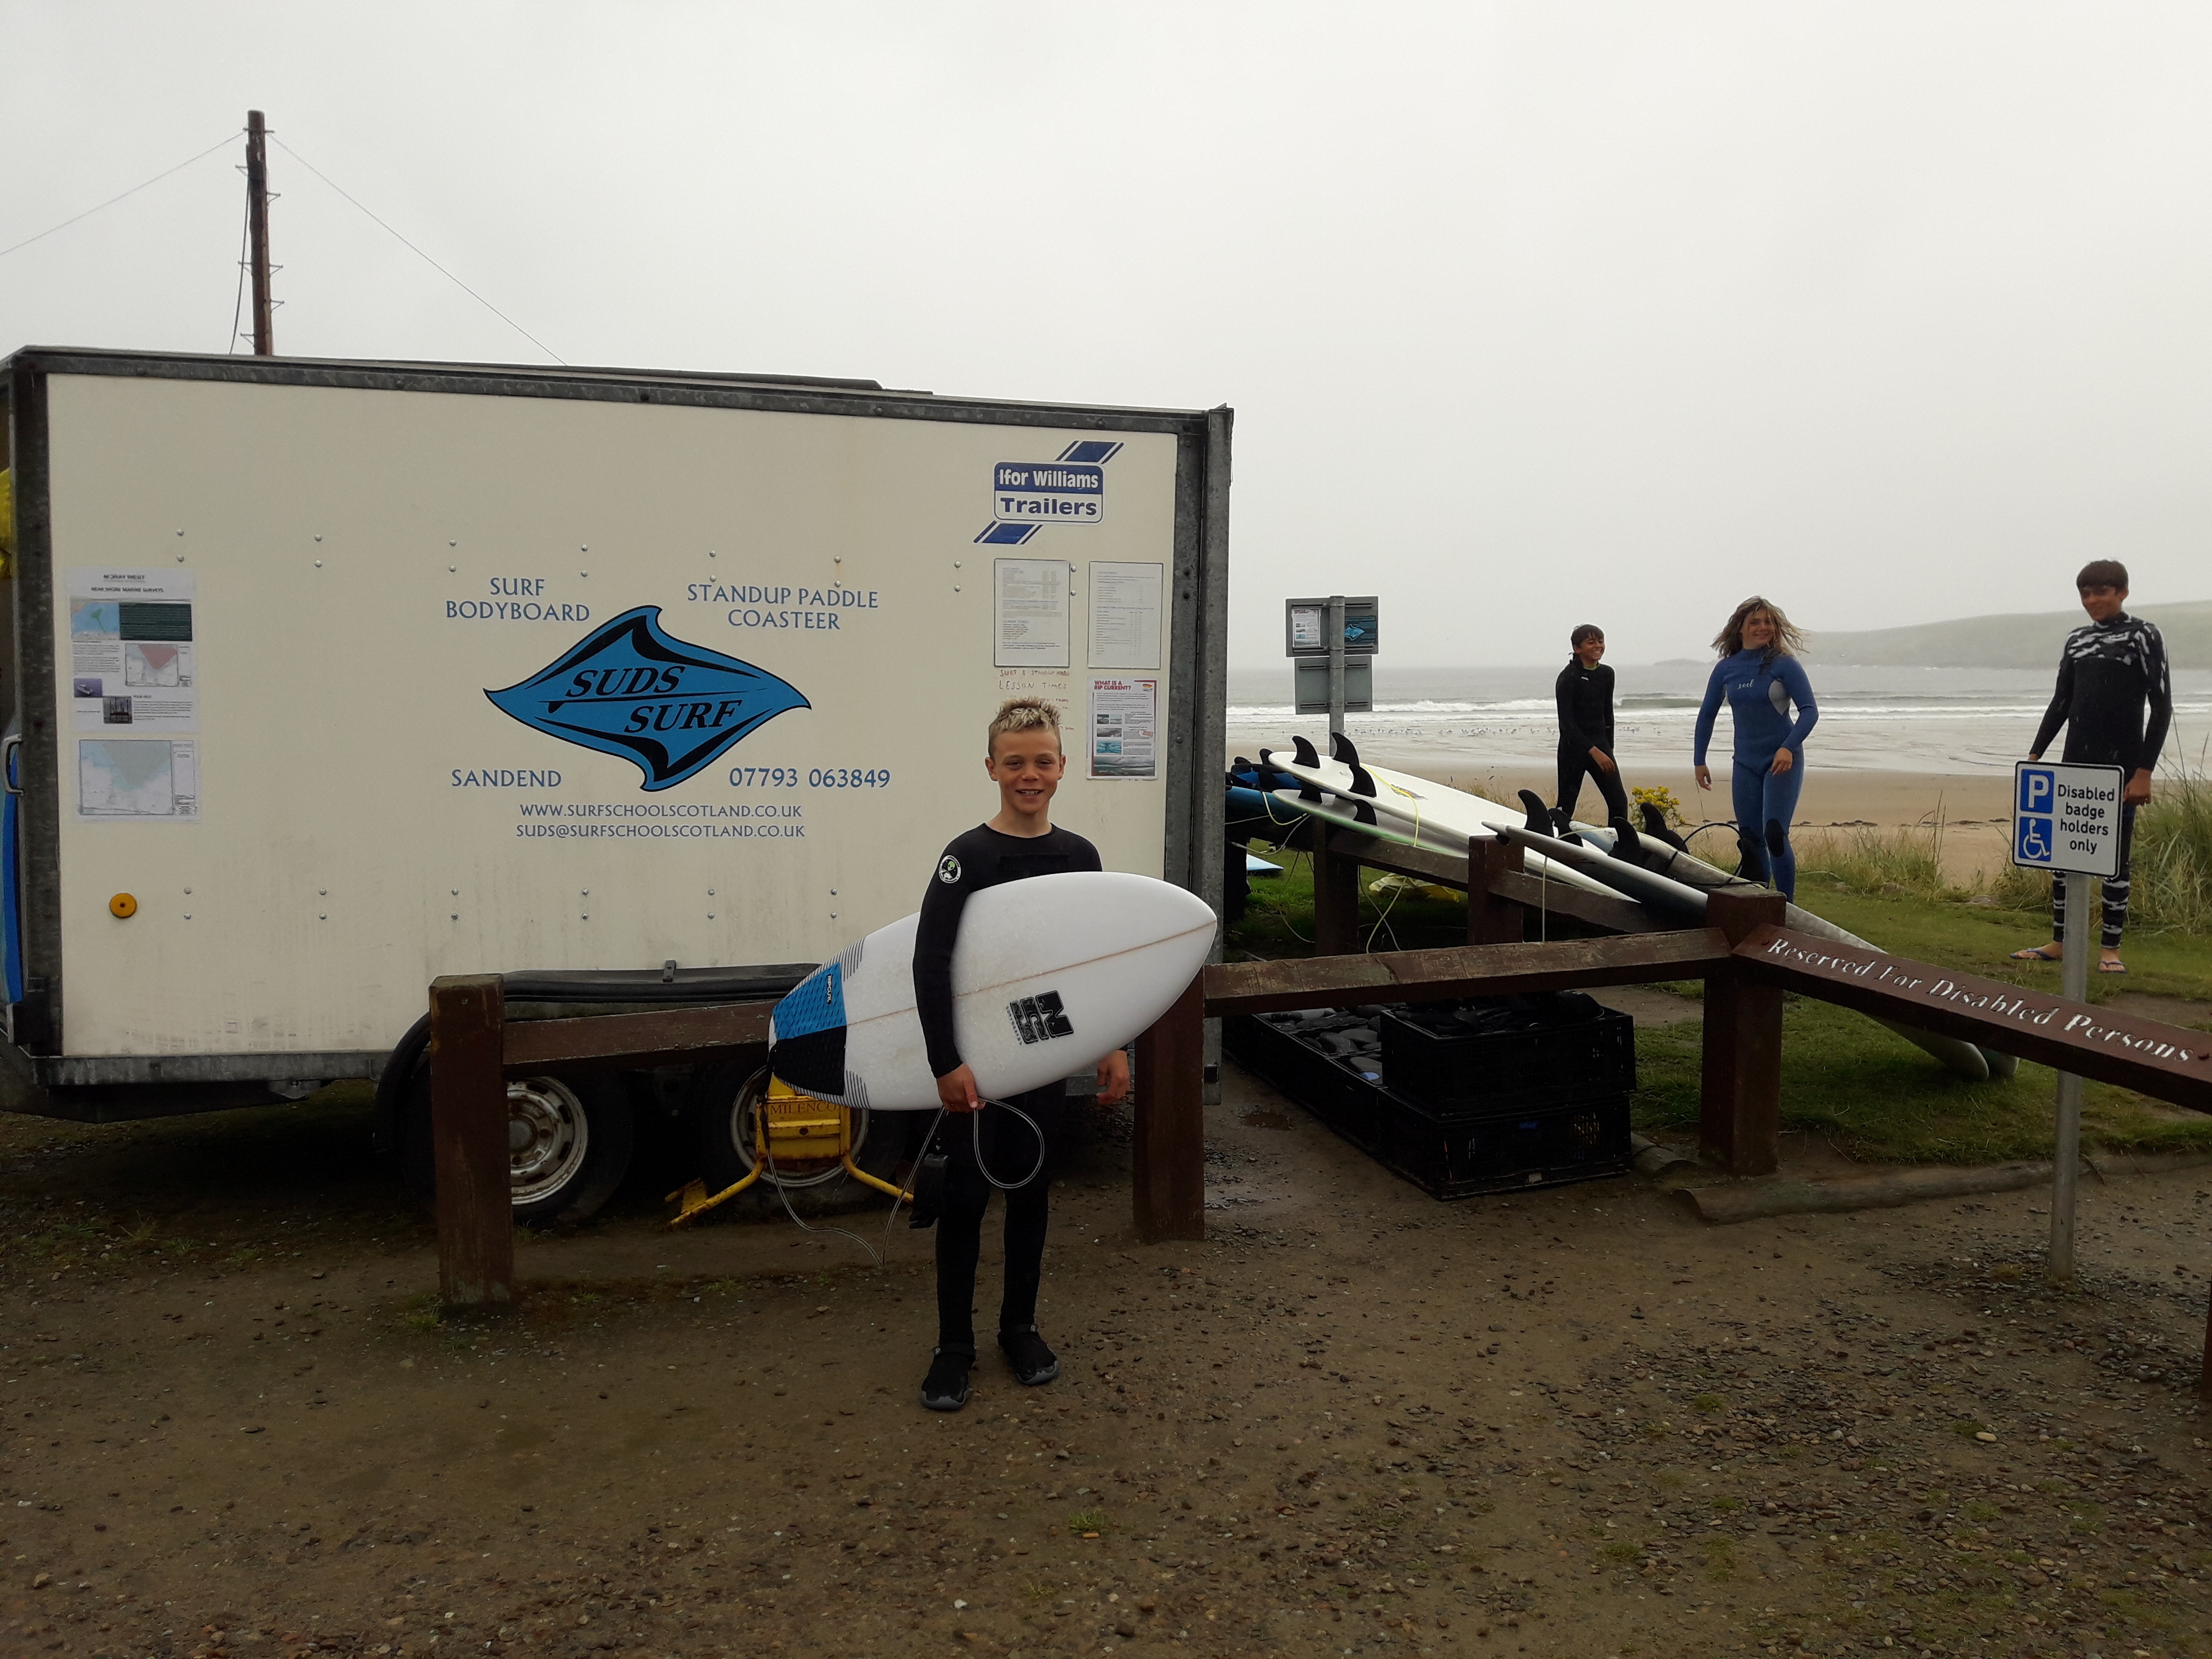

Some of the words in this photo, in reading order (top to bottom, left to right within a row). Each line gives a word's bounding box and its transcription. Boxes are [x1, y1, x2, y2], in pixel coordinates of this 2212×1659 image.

[999, 468, 1028, 485] Ifor
[1033, 470, 1098, 489] Williams
[1000, 497, 1097, 515] Trailers
[490, 577, 545, 596] SURF
[687, 584, 791, 605] STANDUP
[798, 588, 879, 608] PADDLE
[446, 600, 590, 622] BODYBOARD
[728, 609, 841, 630] COASTEER
[565, 666, 686, 697] SUDS
[999, 680, 1035, 690] LESSON
[624, 699, 743, 733] SURF
[451, 768, 562, 788] SANDEND
[729, 766, 798, 788] 07793
[809, 768, 891, 788] 063849
[2028, 774, 2050, 809] P
[2058, 783, 2115, 802] Disabled
[519, 803, 802, 818] WWW.SURFSCHOOLSCOTLAND.CO.UK
[2065, 802, 2105, 820] badge
[515, 824, 805, 839] SUDS@SURFSCHOOLSCOTLAND.CO.UK
[2060, 818, 2109, 836] holders
[2069, 838, 2098, 855] only
[1768, 938, 1876, 977] Reserved
[1874, 965, 1923, 990] For
[1926, 978, 2060, 1026] Disabled
[2062, 1012, 2194, 1062] Persons
[771, 1102, 837, 1114] MILENCO
